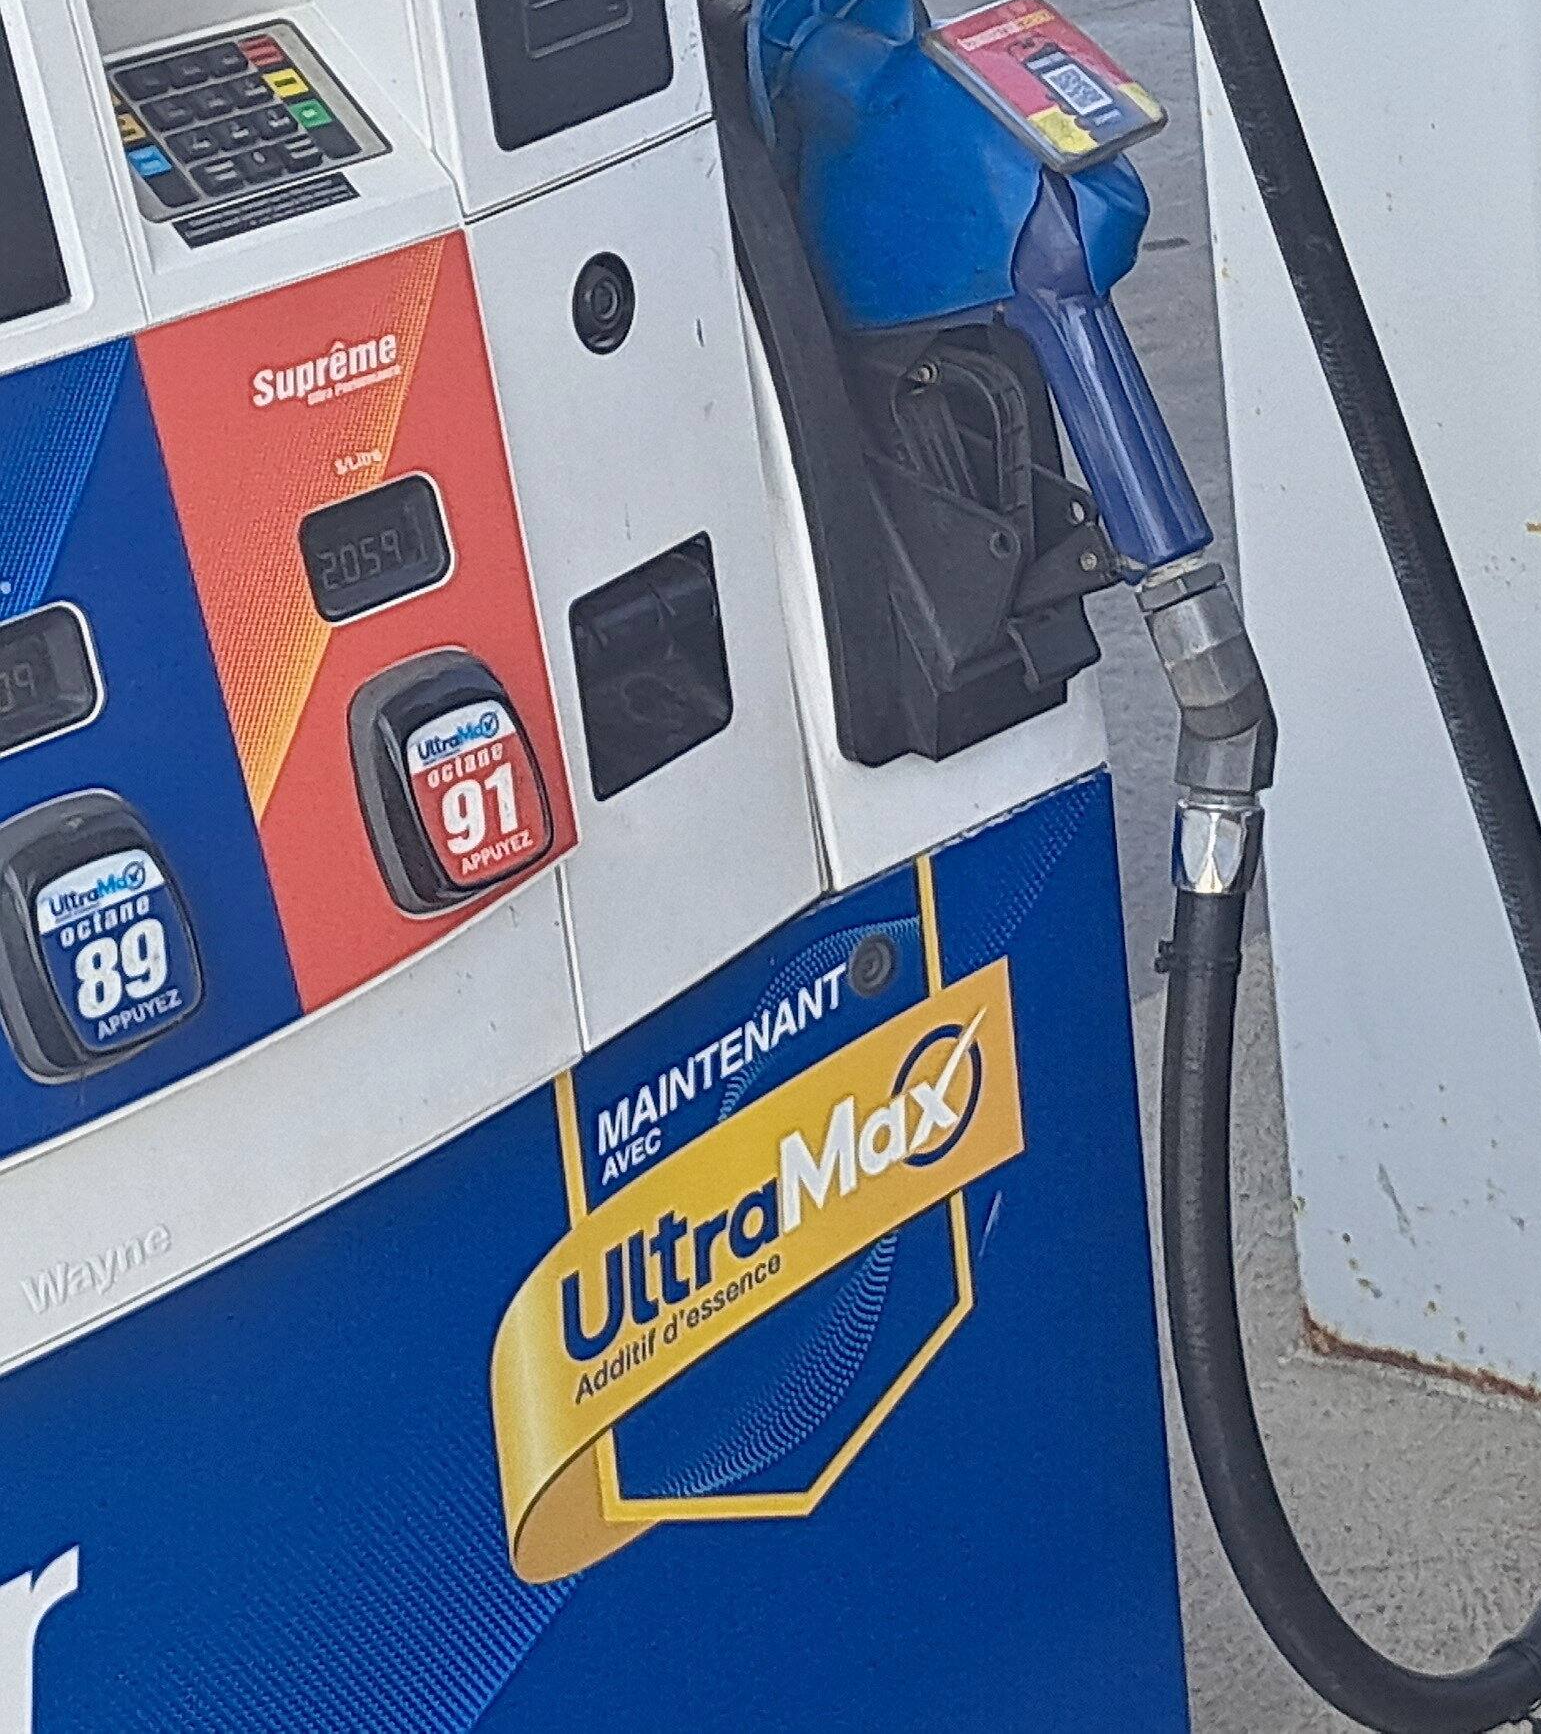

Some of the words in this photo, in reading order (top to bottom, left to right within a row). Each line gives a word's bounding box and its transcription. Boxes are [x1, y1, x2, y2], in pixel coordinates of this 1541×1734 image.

[252, 333, 397, 408] Suprême
[418, 710, 500, 761] UltraMax
[427, 742, 503, 788] octane
[441, 762, 519, 856] 91
[461, 830, 534, 876] APPUYEZ
[50, 860, 146, 919] UltraMax
[60, 894, 151, 949] octane
[74, 918, 168, 1019] 89
[97, 988, 183, 1041] APPUYEZ
[596, 960, 850, 1158] MAINTENANT
[559, 1006, 987, 1363] UltraMax
[601, 1128, 662, 1186] AVEC
[20, 1223, 172, 1316] Wayne
[575, 1334, 657, 1405] Additif
[662, 1253, 781, 1345] d'essence
